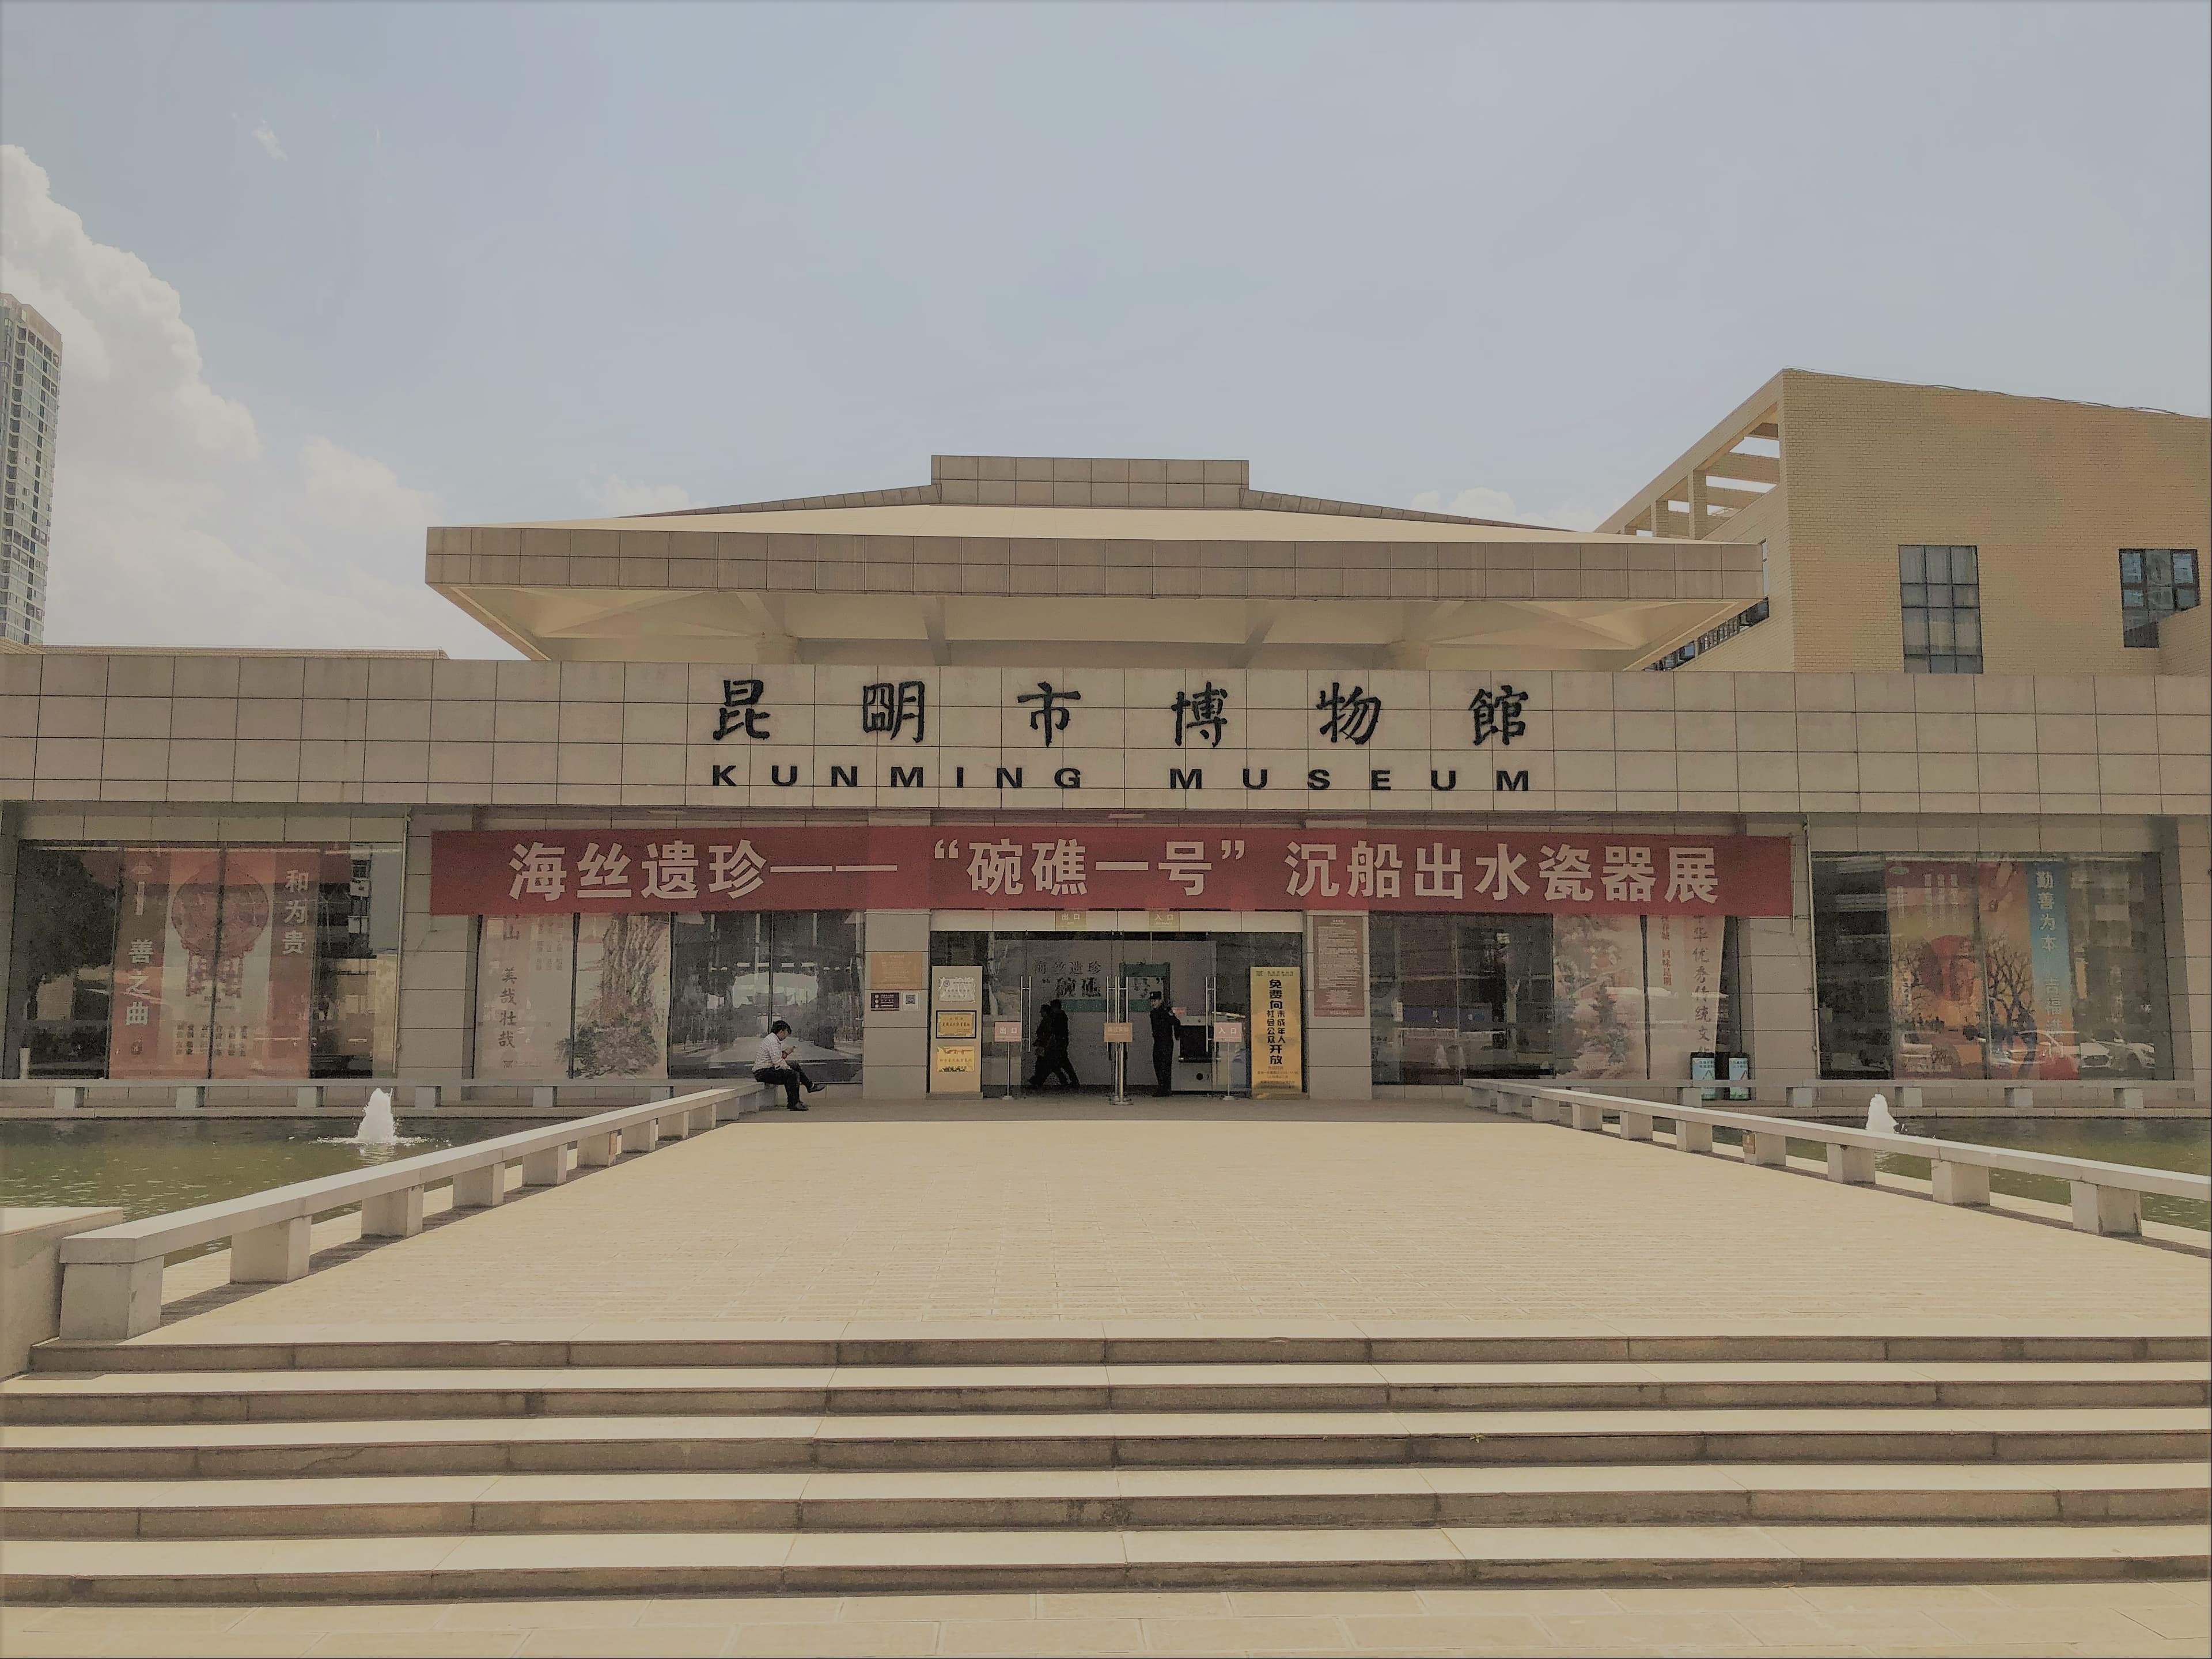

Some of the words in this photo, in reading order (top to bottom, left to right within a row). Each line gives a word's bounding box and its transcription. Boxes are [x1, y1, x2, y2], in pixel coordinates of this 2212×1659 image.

[713, 765, 1081, 789] KUNMING
[1169, 768, 1529, 791] MUSEUM
[1284, 840, 1719, 904] 沉船出水瓷器展
[282, 869, 309, 955] 和为贵
[1269, 979, 1283, 1010] 免费向
[999, 1027, 1017, 1035] 出口
[1218, 1027, 1237, 1035] 入口
[1277, 1010, 1286, 1043] 未成年人
[1270, 1044, 1283, 1065] 开放
